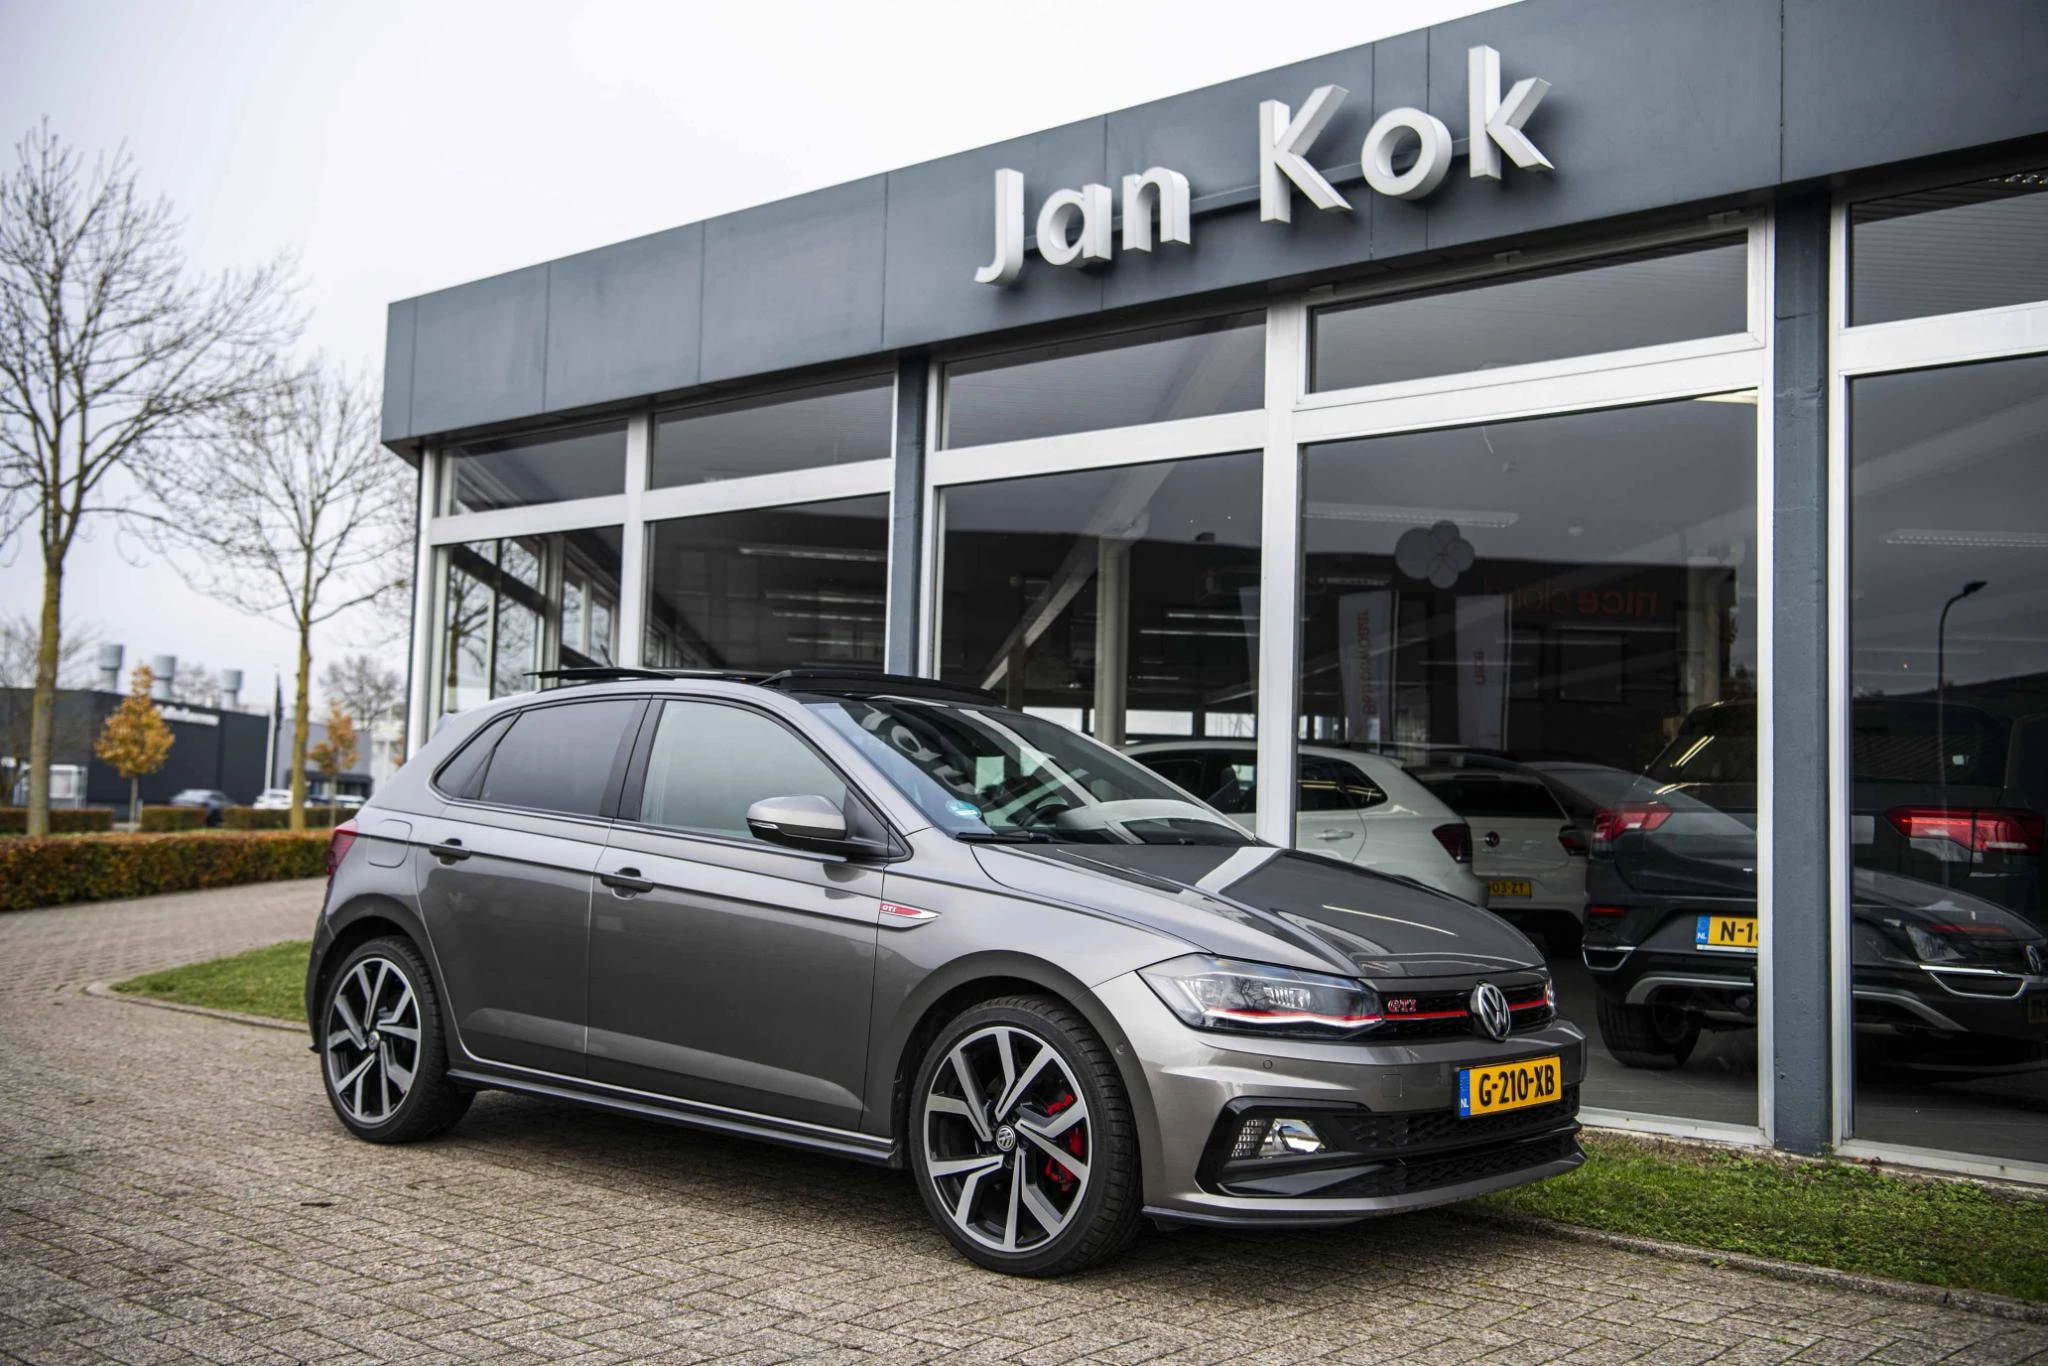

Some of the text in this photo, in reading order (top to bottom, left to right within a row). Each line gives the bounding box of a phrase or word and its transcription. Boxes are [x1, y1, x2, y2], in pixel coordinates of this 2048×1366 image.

[975, 45, 1555, 287] Jan Kok
[882, 904, 897, 913] GTI
[1696, 932, 1708, 940] NL
[1719, 920, 1758, 943] N-1
[1387, 999, 1417, 1013] GTI
[1478, 1063, 1555, 1107] G-210-XB
[1460, 1097, 1469, 1108] NL
